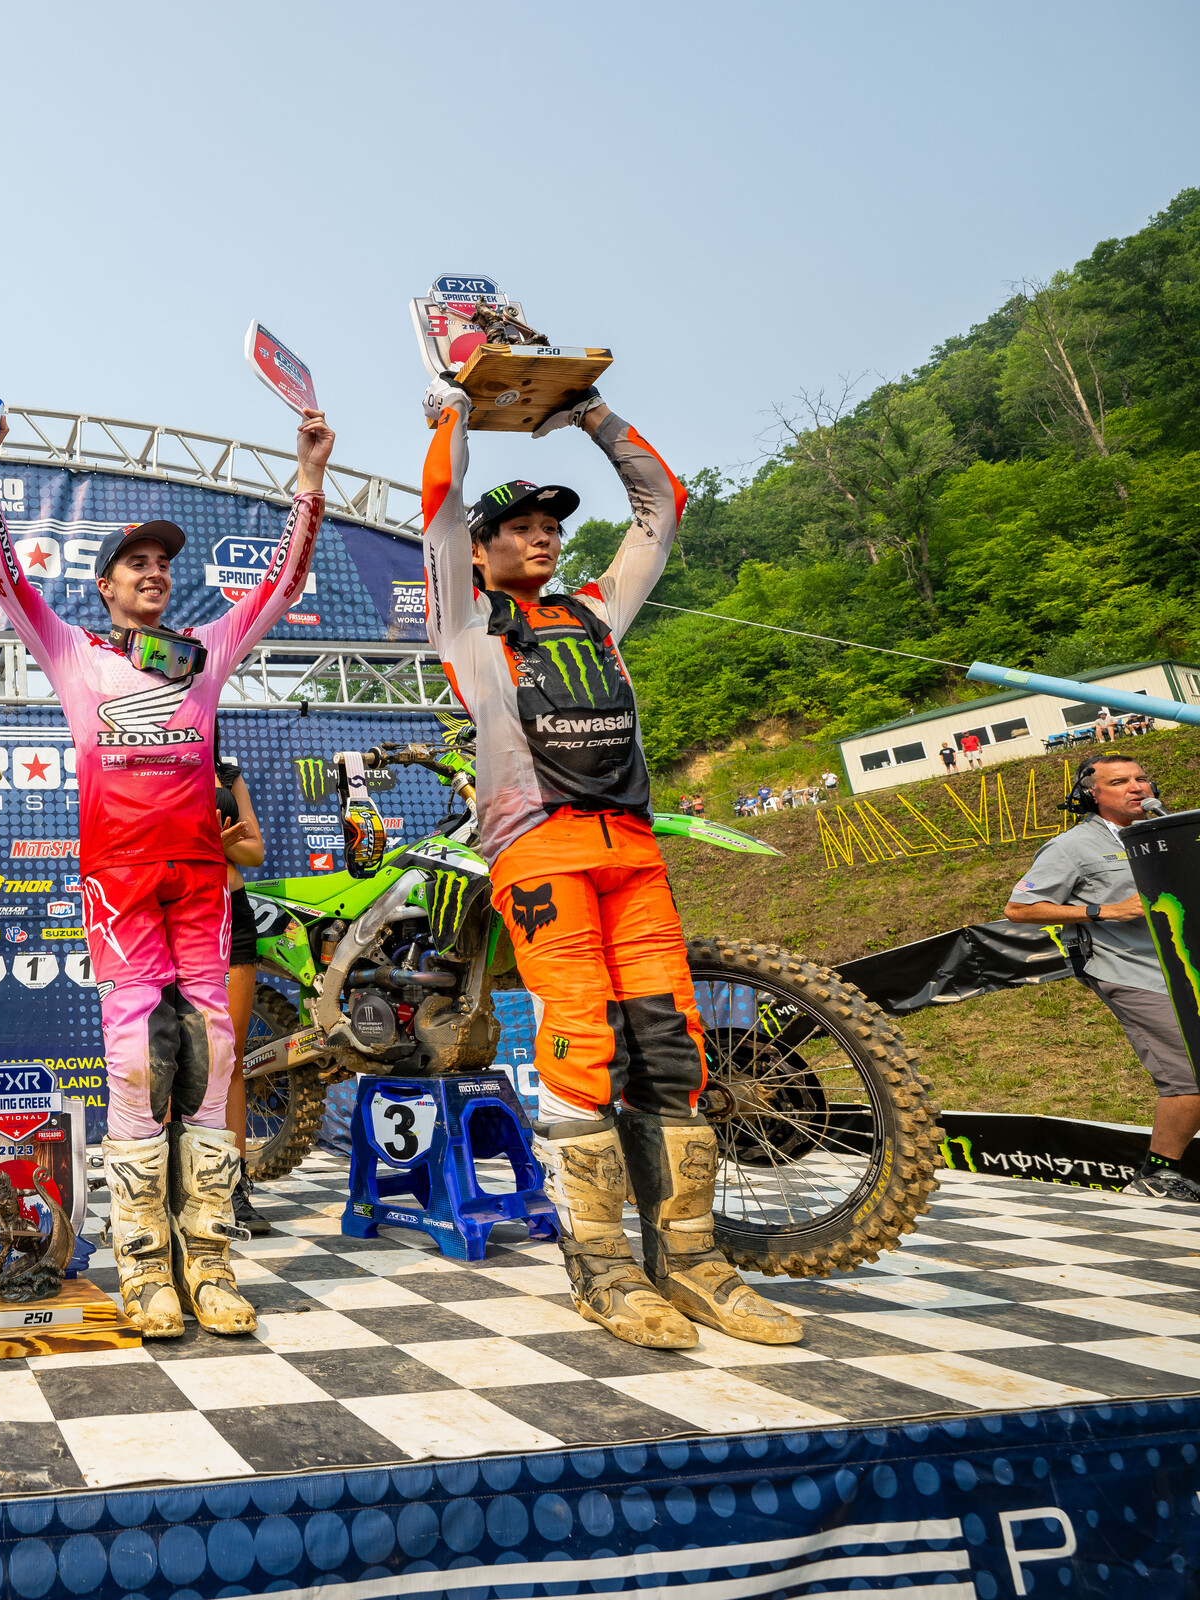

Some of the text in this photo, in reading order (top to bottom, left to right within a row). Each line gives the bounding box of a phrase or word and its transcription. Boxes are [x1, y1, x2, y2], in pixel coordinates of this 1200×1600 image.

[445, 279, 487, 292] FXR
[442, 293, 471, 301] SPRING
[266, 500, 302, 585] HONDA
[218, 570, 262, 585] SPRING
[397, 596, 426, 604] MOT
[288, 613, 318, 622] FRESCADOS
[177, 655, 188, 664] 96
[535, 711, 634, 733] Kawasaki
[98, 727, 204, 746] HONDA
[545, 736, 631, 750] PRO CIRCUIT
[133, 756, 177, 765] SHOWA
[298, 814, 338, 824] GEICO
[366, 819, 375, 860] SCOTT
[413, 841, 464, 861] KX
[3, 880, 53, 892] THOR
[50, 904, 73, 915] 100%
[45, 930, 84, 938] SUZUKI
[458, 1083, 501, 1093] MOTOCROSS
[18, 1096, 51, 1109] CREEK
[37, 1130, 62, 1138] FRESCADOS
[383, 1103, 419, 1160] 3
[980, 1150, 1136, 1179] MONSTER
[23, 1311, 53, 1324] 250
